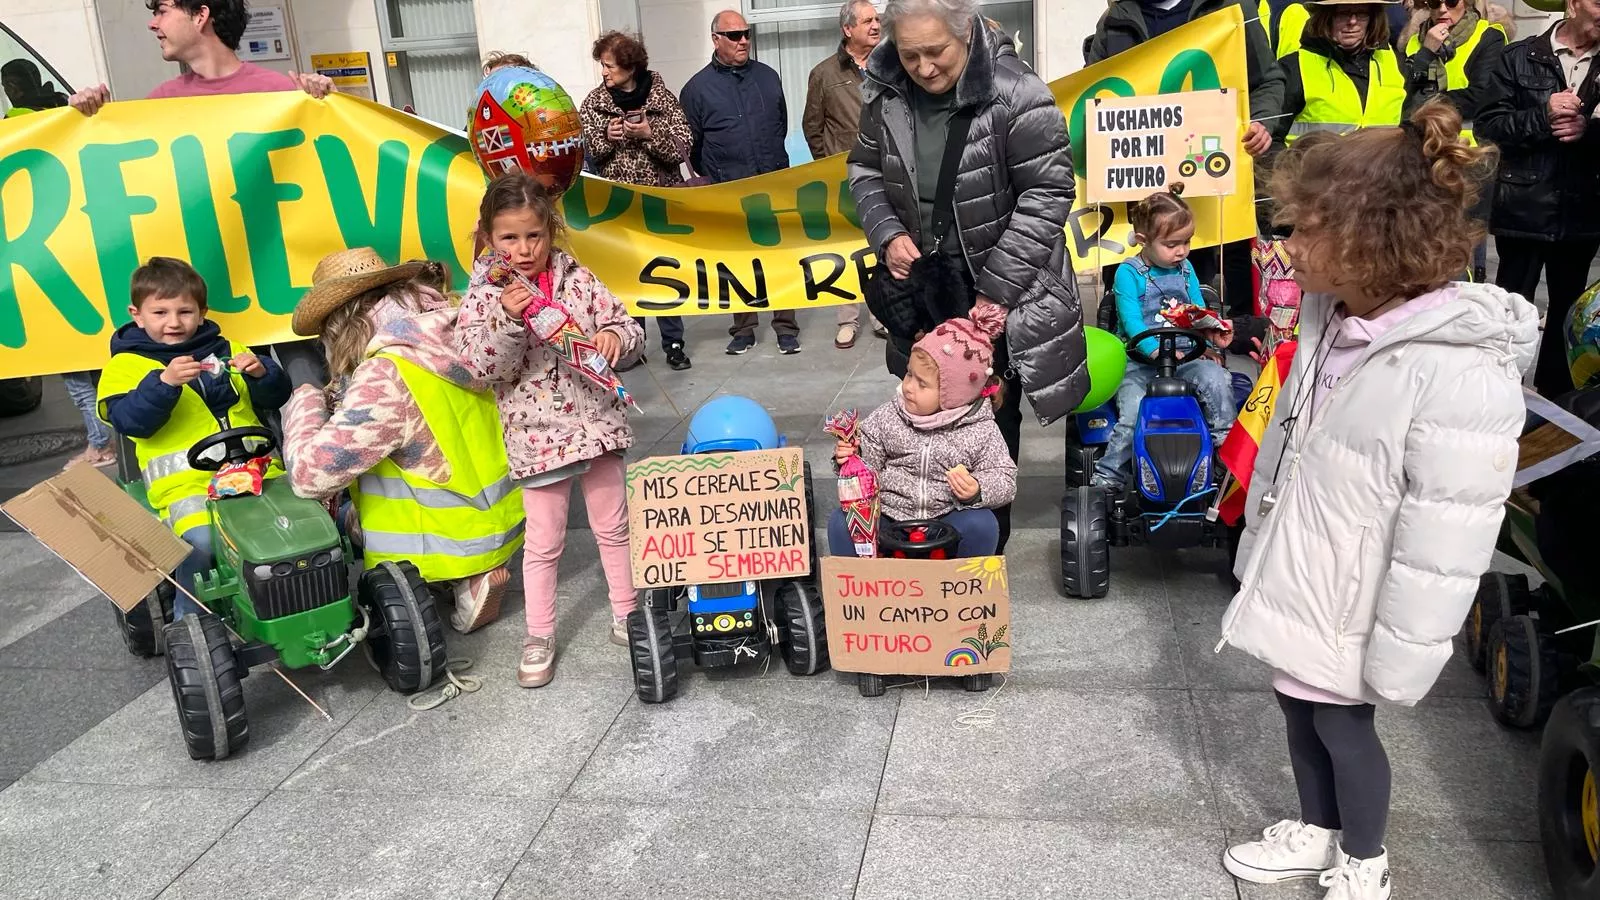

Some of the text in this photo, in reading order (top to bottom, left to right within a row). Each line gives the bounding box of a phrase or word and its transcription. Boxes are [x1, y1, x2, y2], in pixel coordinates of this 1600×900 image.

[1097, 106, 1183, 132] LUCHAMOS
[1111, 135, 1164, 159] POR MI
[1107, 166, 1166, 189] FUTURO
[636, 255, 770, 311] SIN
[799, 248, 880, 301] RE
[643, 469, 780, 500] MIS CEREALES
[642, 497, 802, 529] PARA DESAYUNAR
[642, 523, 805, 560] AQUI SE TIENEN
[644, 550, 805, 585] QUE SEMBRAR
[837, 574, 983, 598] JUNTOS POR
[842, 603, 997, 623] UN CAMPO CON
[842, 633, 932, 653] FUTURO
